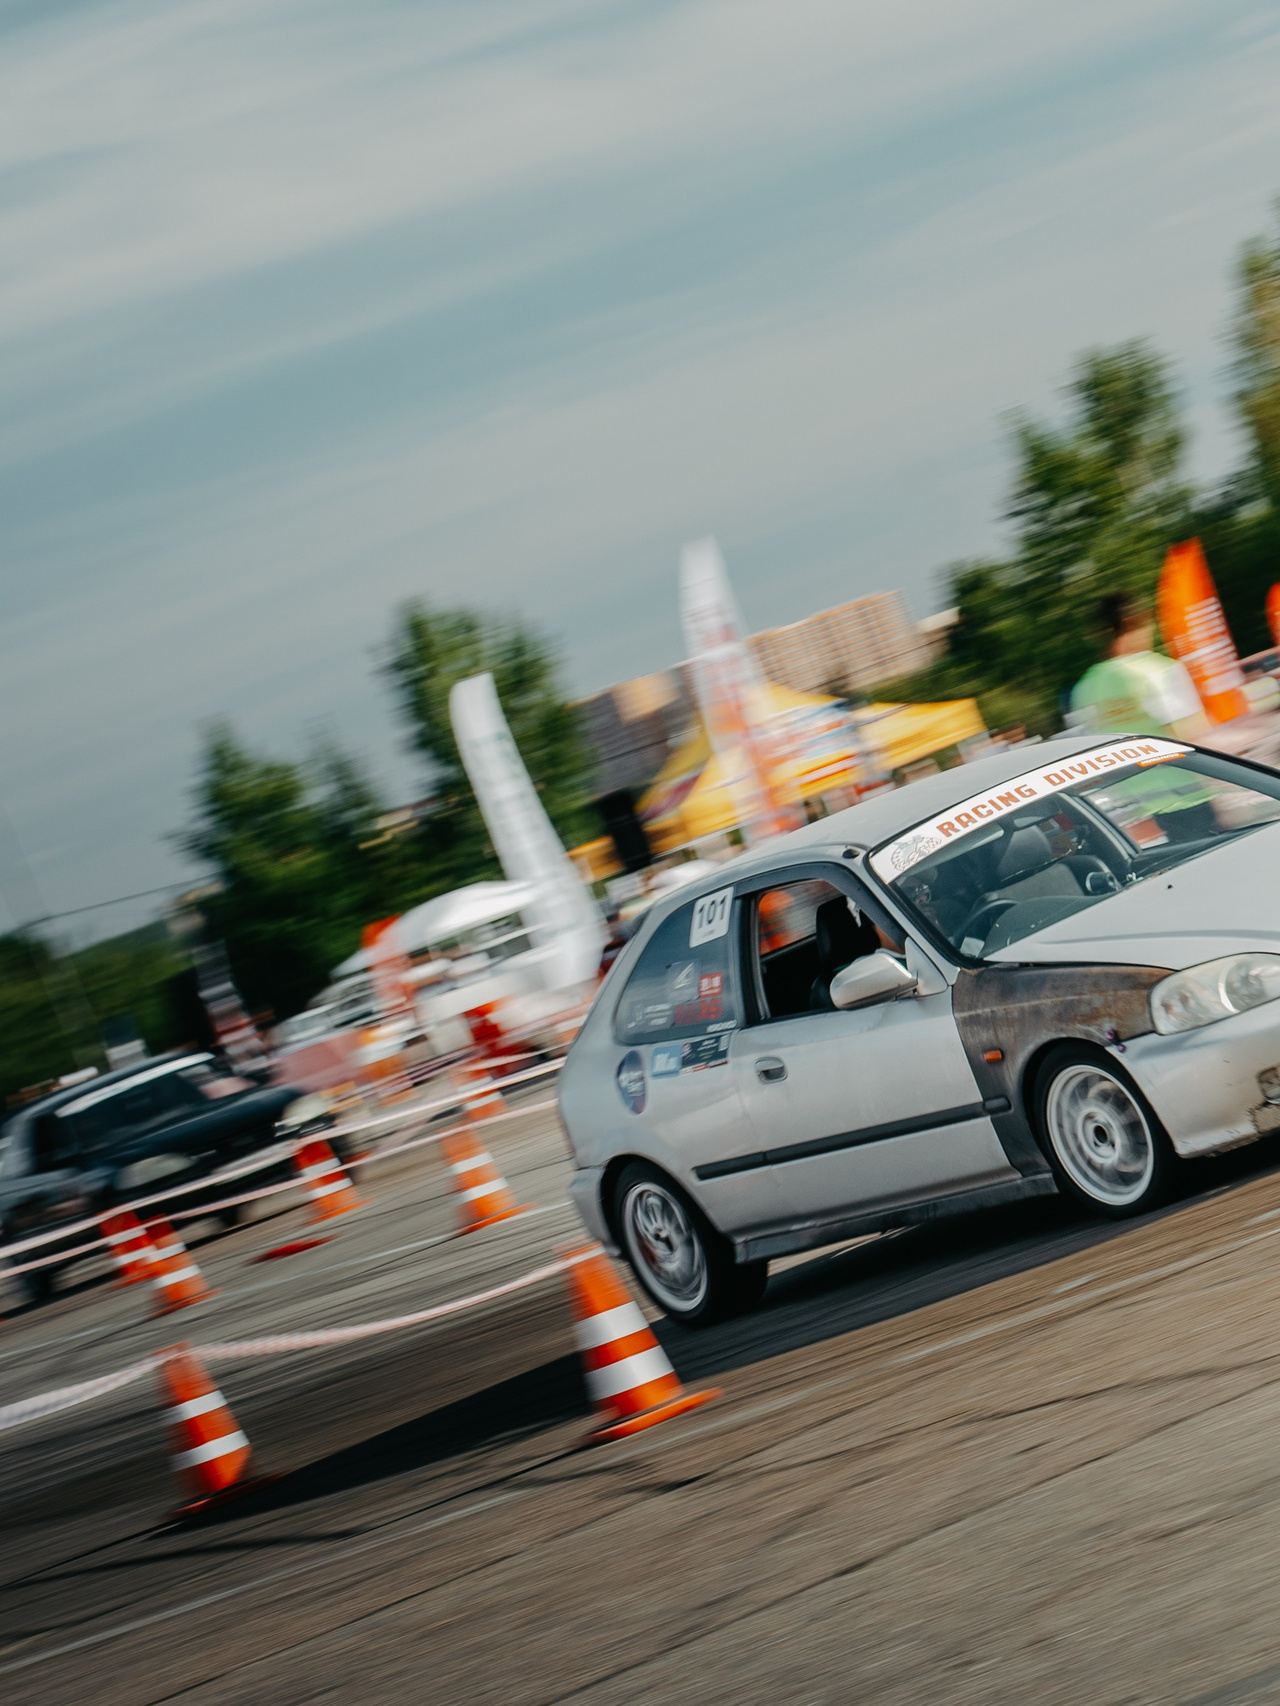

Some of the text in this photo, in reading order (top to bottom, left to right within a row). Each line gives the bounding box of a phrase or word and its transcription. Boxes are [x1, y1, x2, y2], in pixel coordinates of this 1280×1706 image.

[937, 744, 1158, 838] RACING DIVISION
[698, 895, 727, 930] 101
